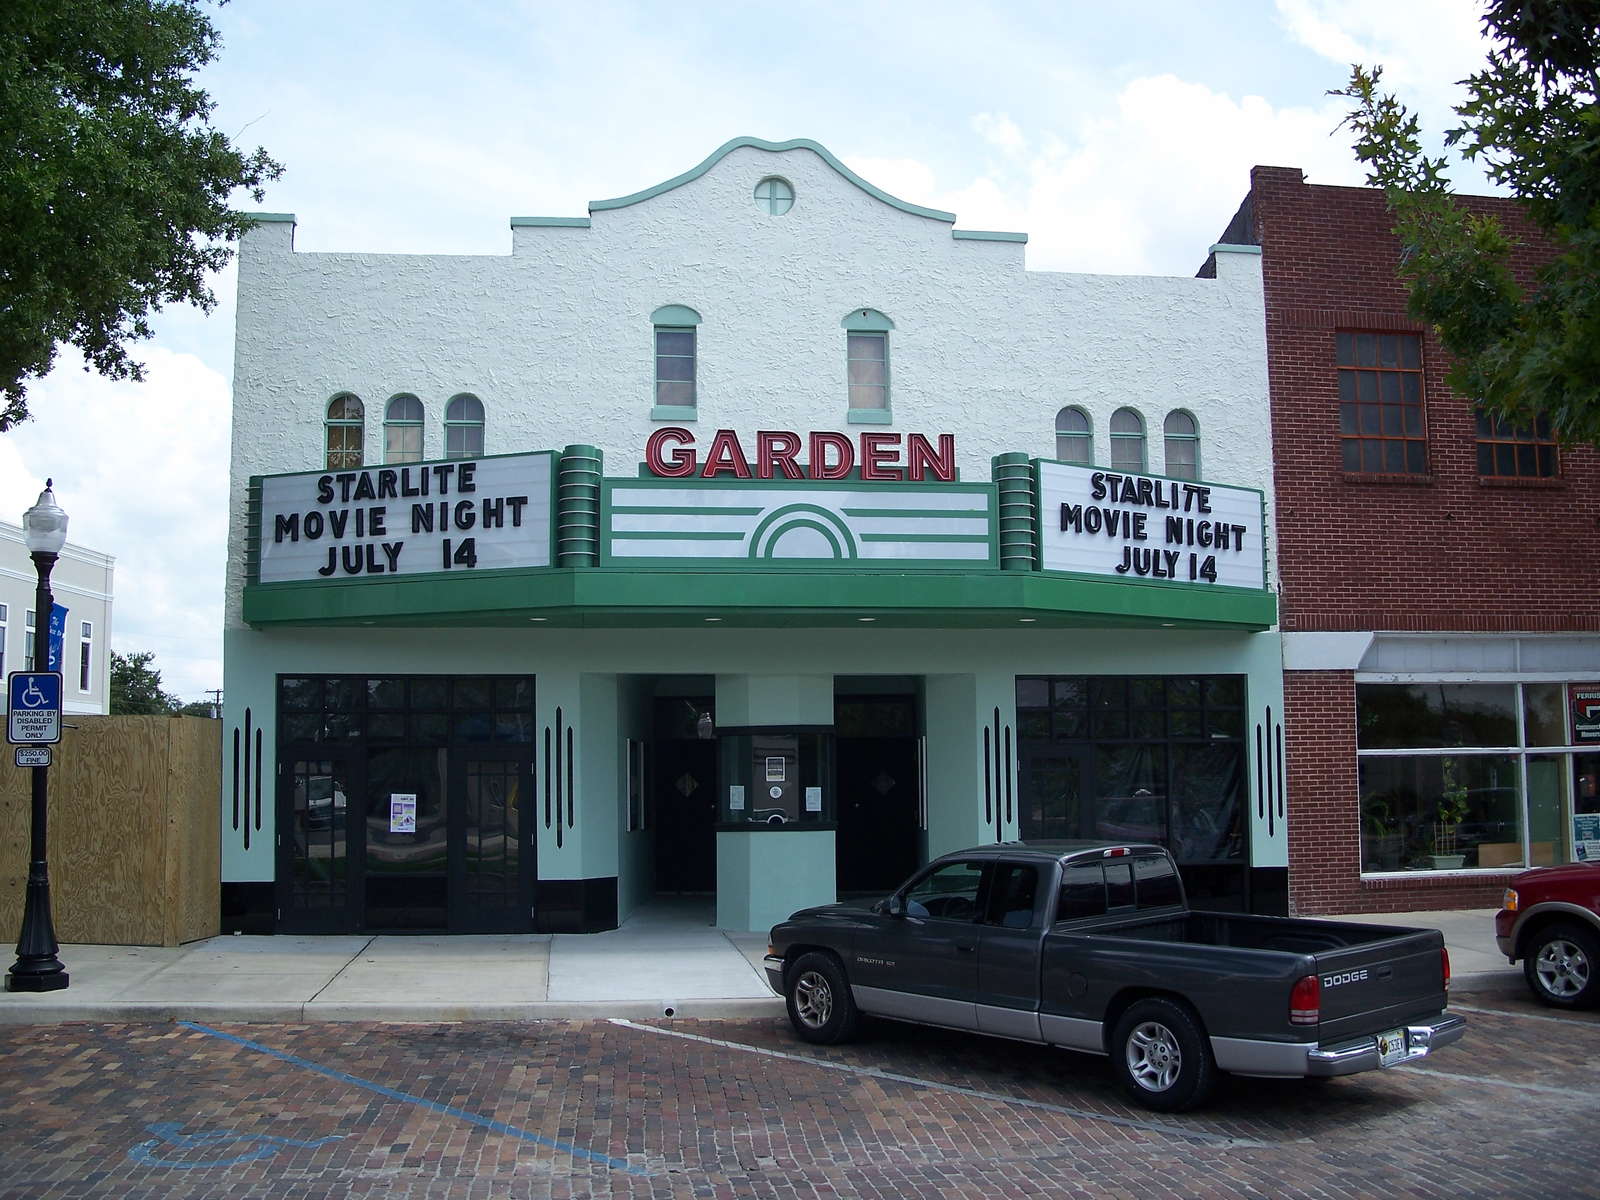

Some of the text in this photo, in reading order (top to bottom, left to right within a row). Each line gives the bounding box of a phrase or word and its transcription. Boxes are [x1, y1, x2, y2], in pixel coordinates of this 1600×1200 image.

[645, 427, 956, 482] GARDEN
[317, 462, 478, 504] STARLITE
[1091, 471, 1212, 514] STARLITE
[274, 495, 529, 543] MOVIE NIGHT
[1060, 502, 1247, 552] MOVIE NIGHT
[317, 537, 478, 577] JULY 14
[1114, 545, 1218, 583] JULY 14
[19, 749, 48, 757] $250.00
[1323, 969, 1368, 988] DODGE
